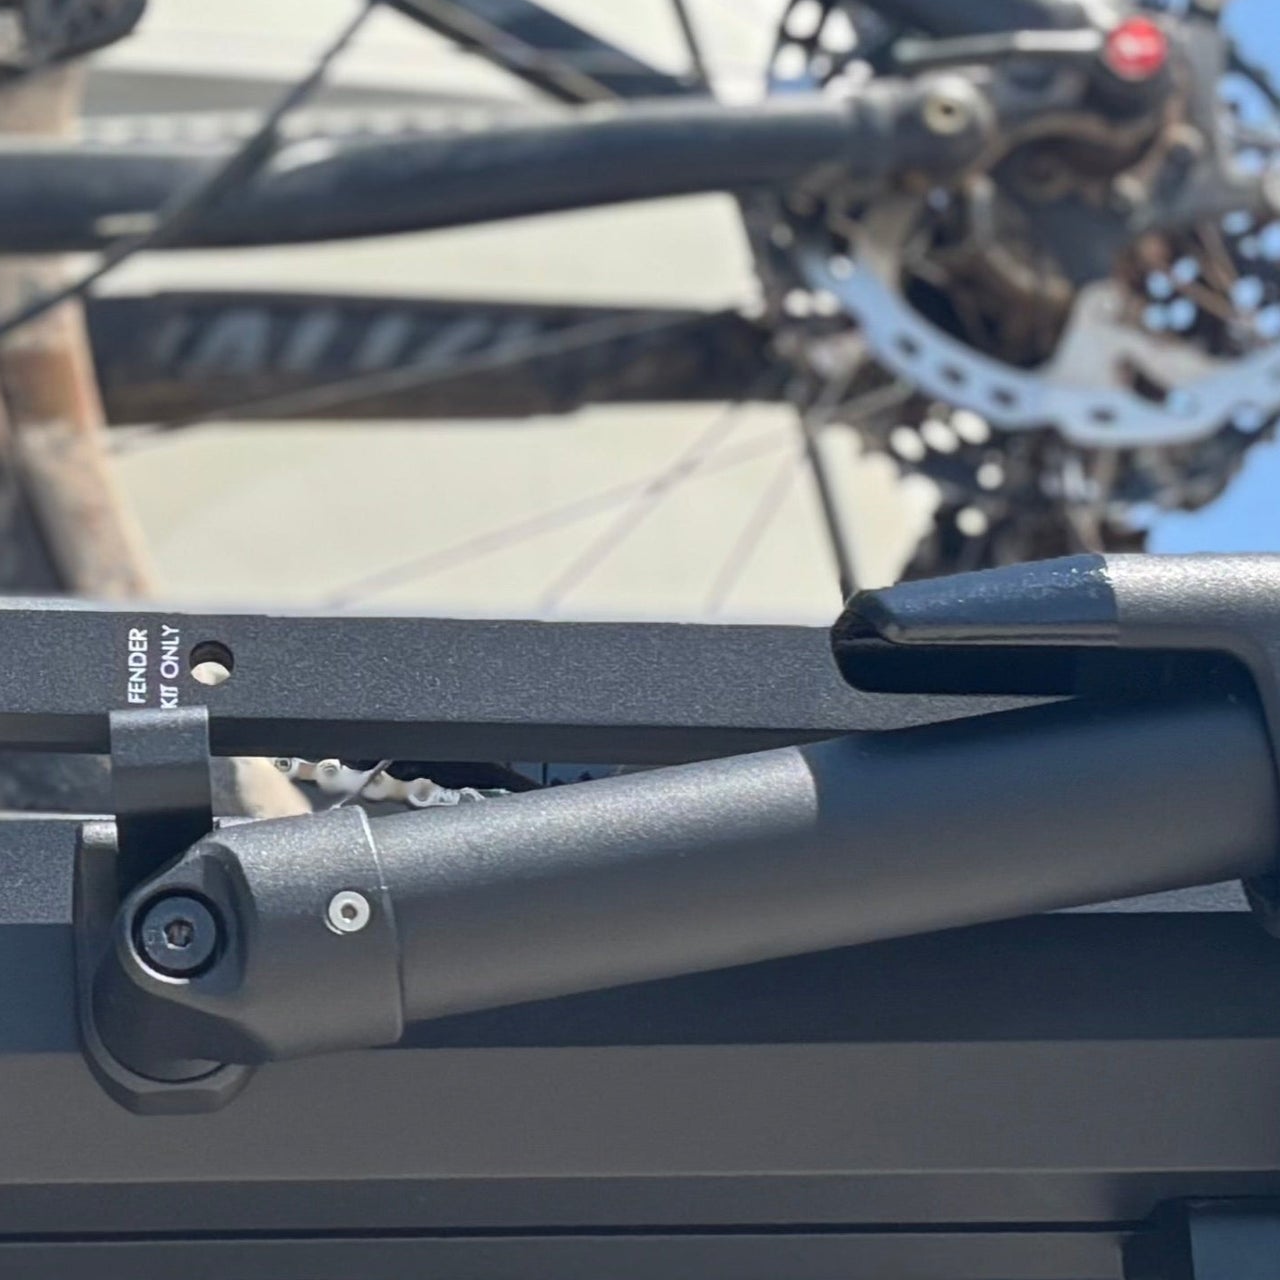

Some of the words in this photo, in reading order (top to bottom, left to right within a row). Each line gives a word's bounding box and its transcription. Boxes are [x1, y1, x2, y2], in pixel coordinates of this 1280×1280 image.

[127, 627, 149, 704] FENDER
[160, 624, 181, 679] ONLY
[159, 683, 180, 709] KIT
